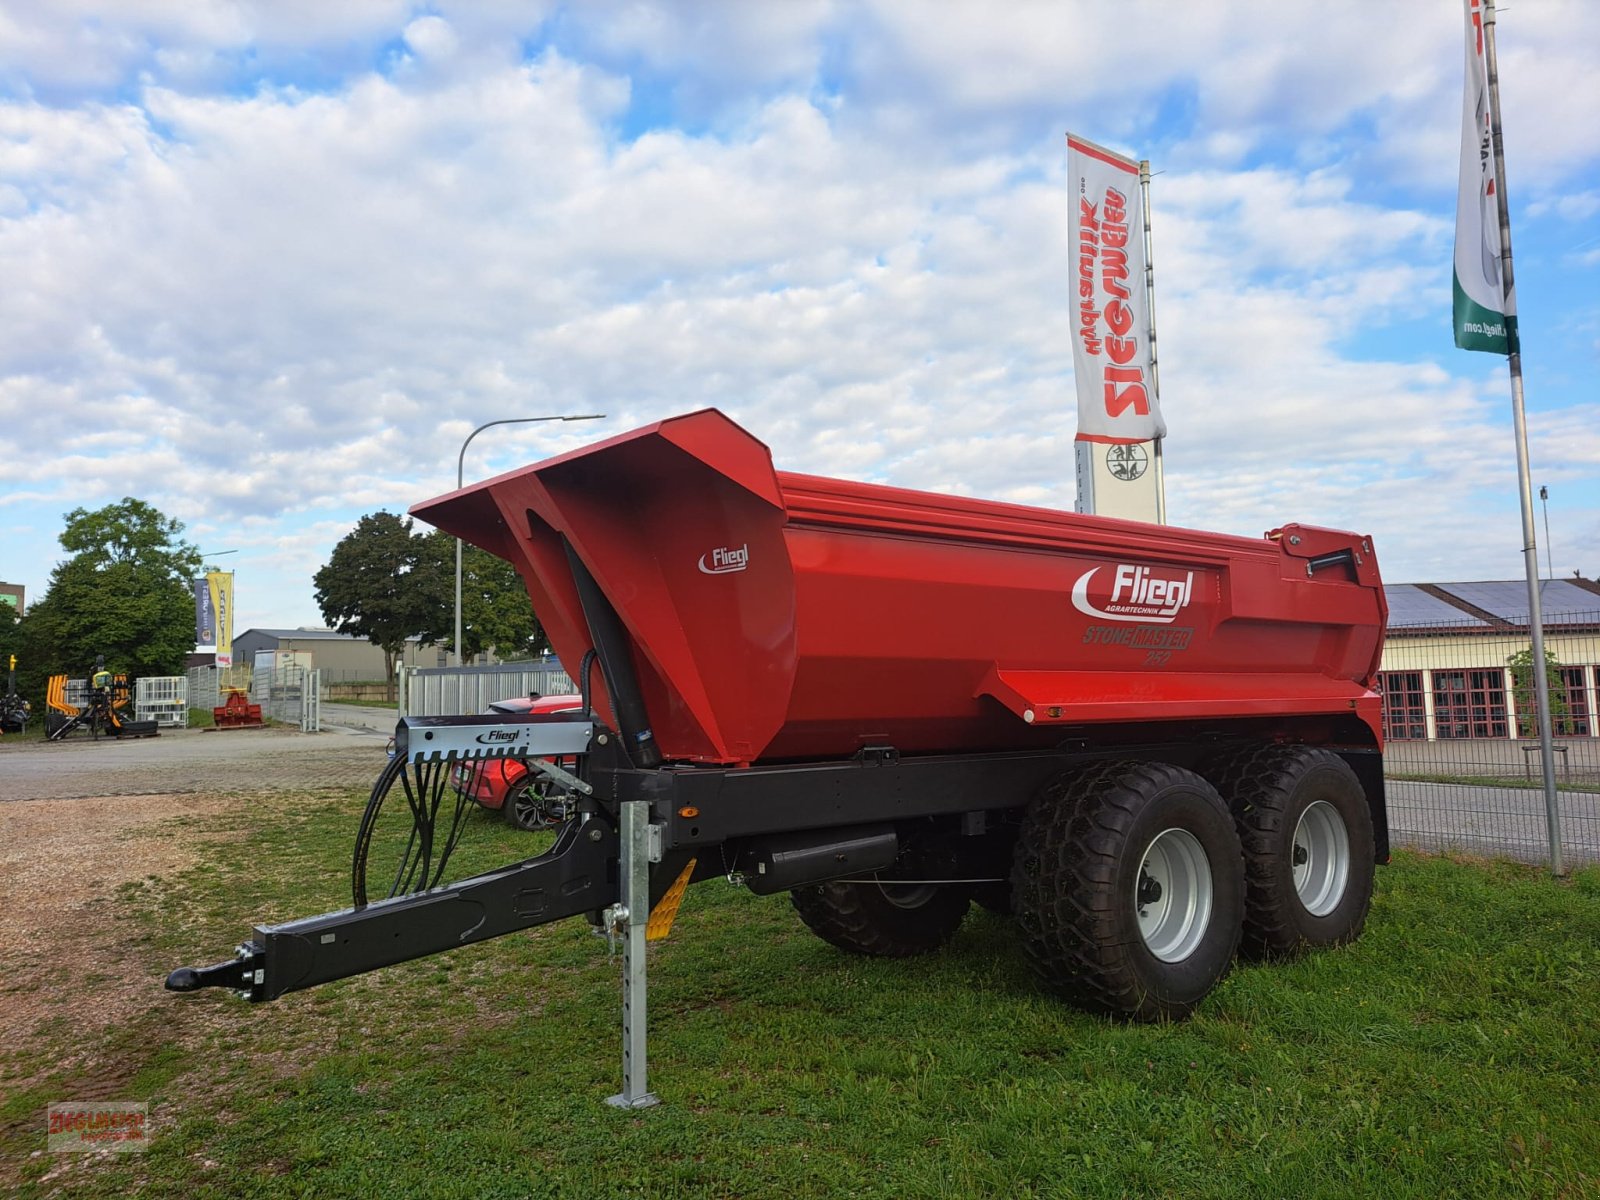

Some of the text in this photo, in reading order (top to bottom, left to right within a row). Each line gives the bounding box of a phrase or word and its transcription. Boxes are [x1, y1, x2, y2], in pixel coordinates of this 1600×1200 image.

[712, 543, 749, 568] Fliegl
[1110, 564, 1194, 615] Fliegl
[1104, 604, 1159, 615] AGRARTECHNIK
[1144, 651, 1171, 666] 252
[488, 729, 520, 743] Fliegl
